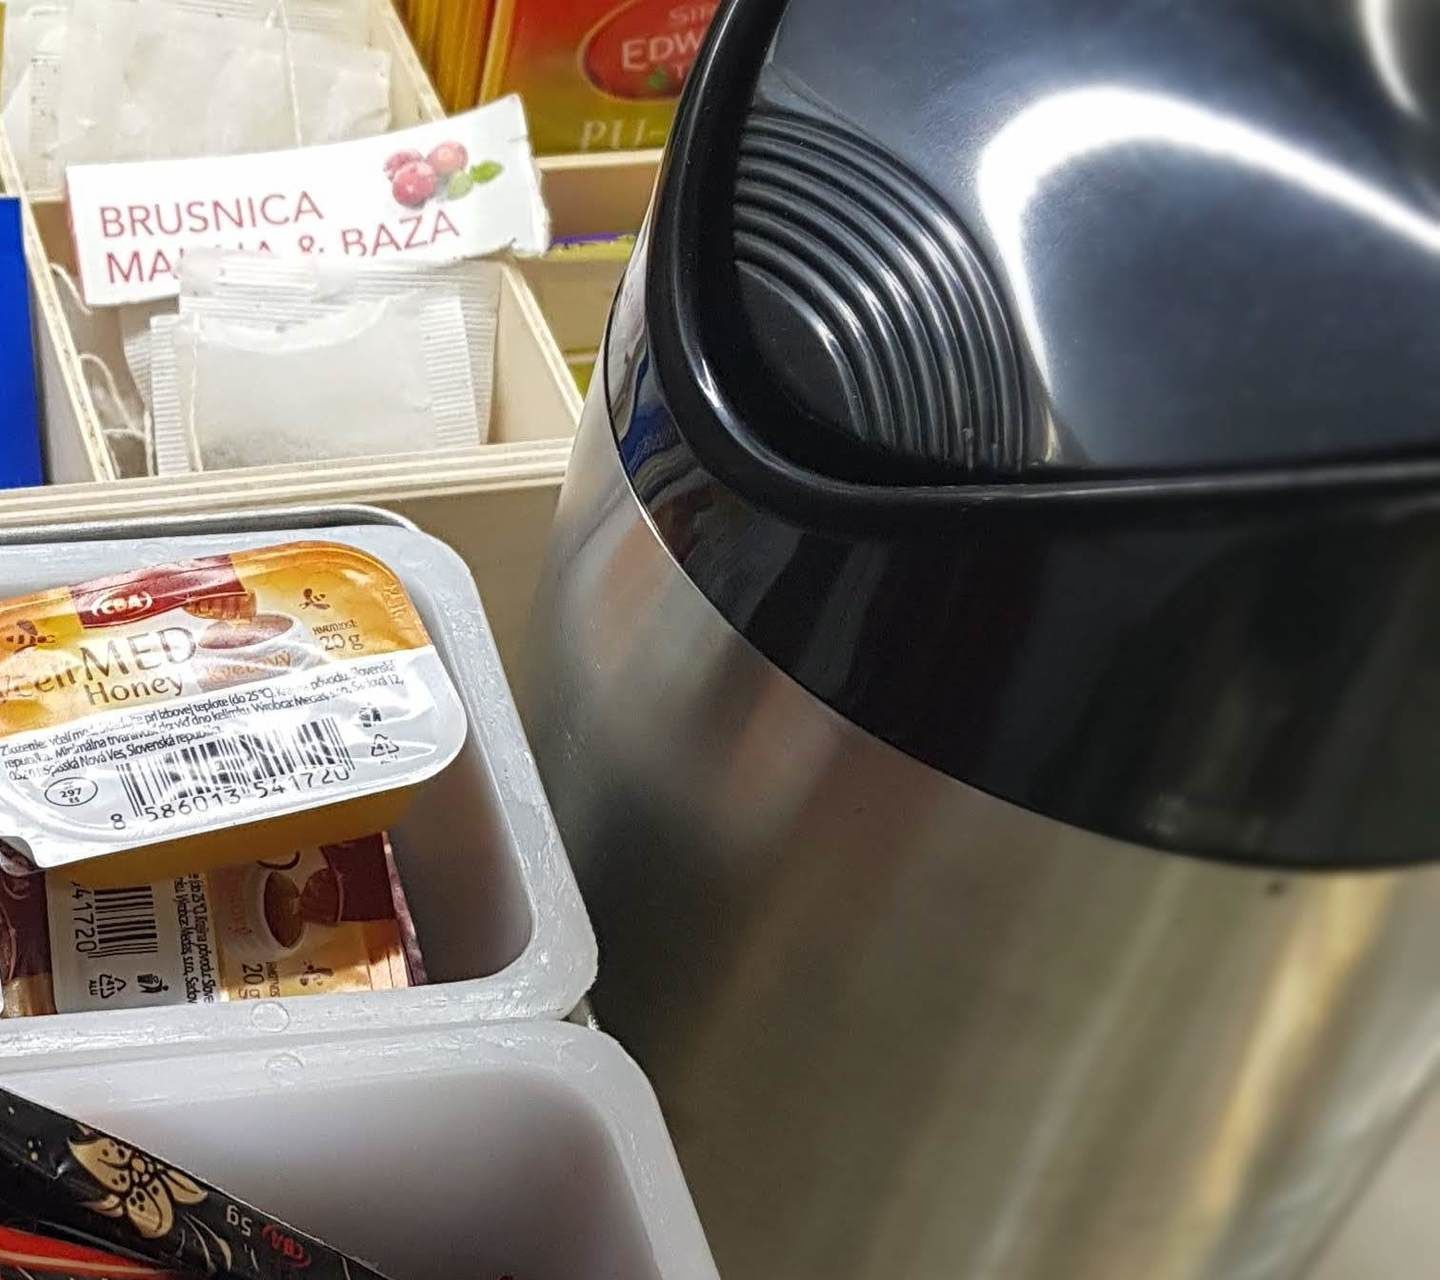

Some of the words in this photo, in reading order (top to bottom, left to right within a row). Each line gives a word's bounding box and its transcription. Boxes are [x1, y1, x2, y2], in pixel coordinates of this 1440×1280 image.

[621, 30, 704, 70] EDW
[99, 190, 324, 239] BRUSNICA
[341, 209, 461, 257] BAZA
[80, 626, 198, 682] MED
[348, 632, 364, 651] g
[83, 673, 185, 706] Honey
[59, 786, 83, 800] 297
[110, 812, 127, 831] 8
[144, 787, 242, 823] 586013
[89, 978, 99, 996] ALU
[242, 962, 265, 985] 20
[225, 1204, 252, 1237] 5g
